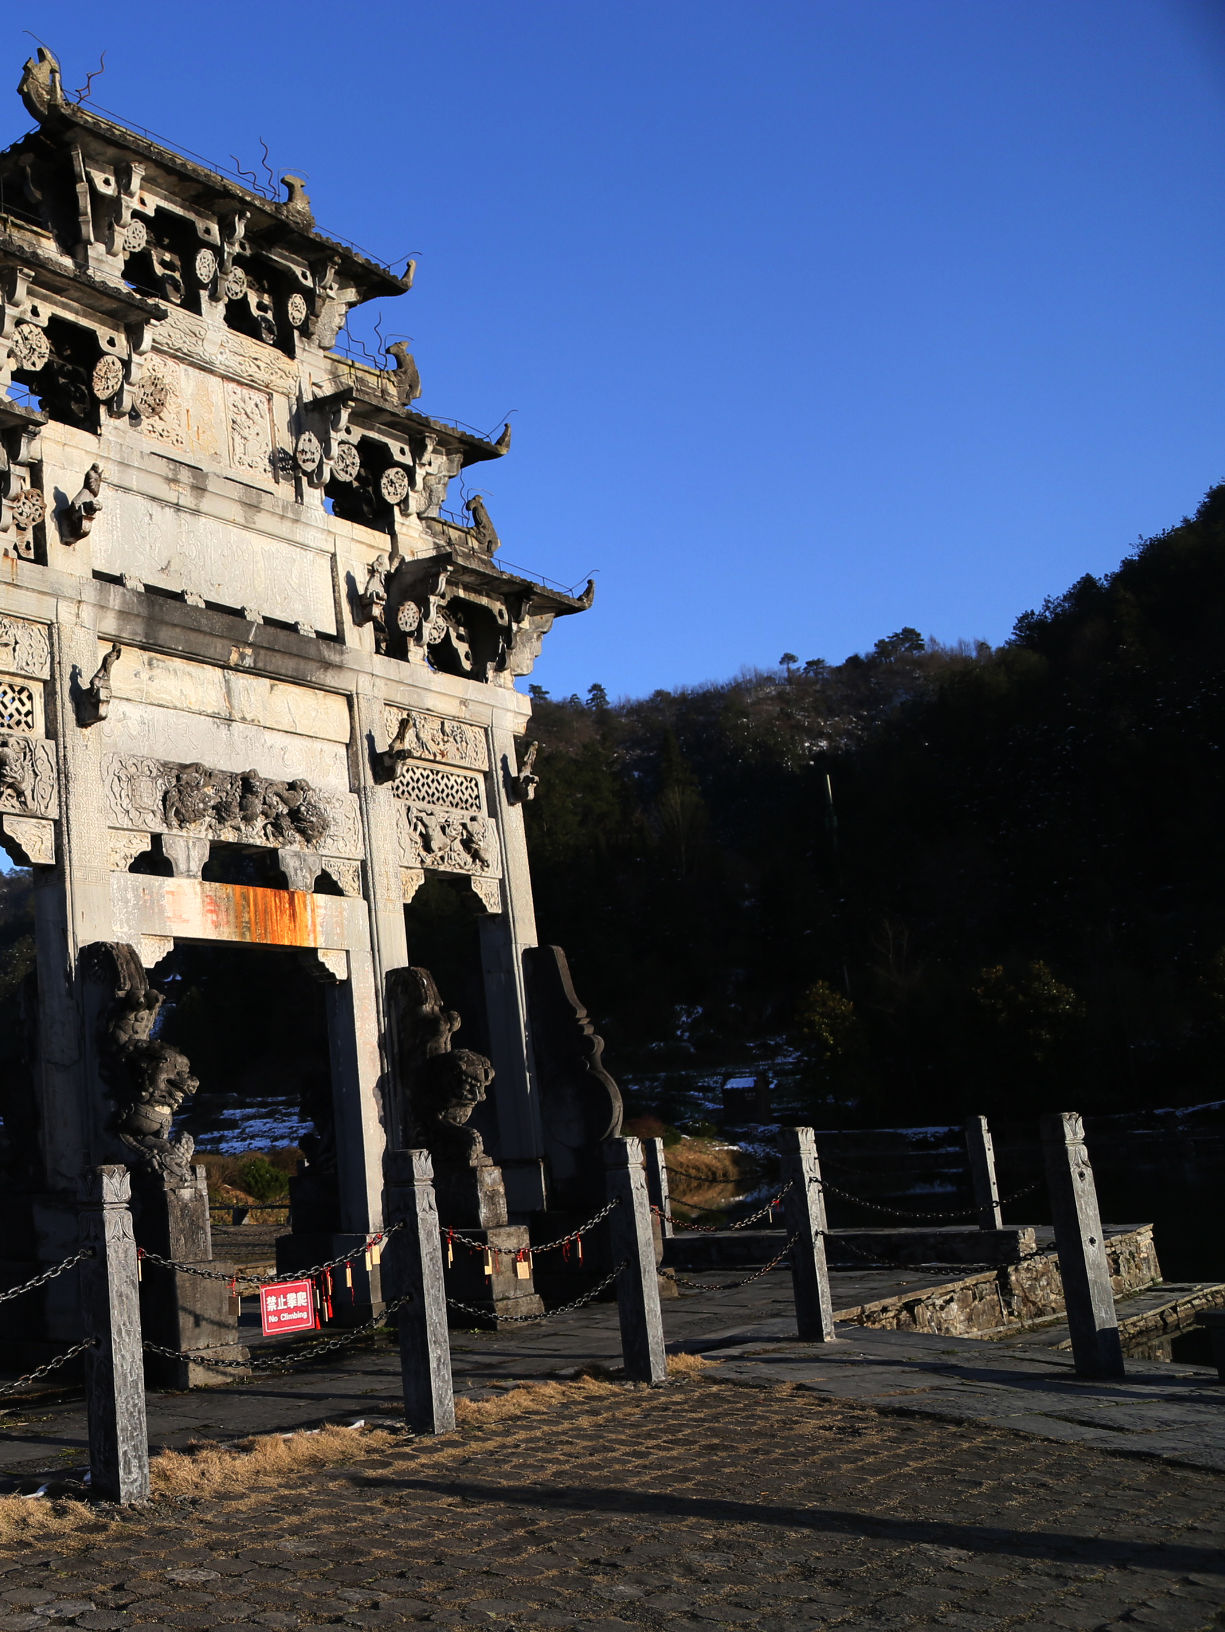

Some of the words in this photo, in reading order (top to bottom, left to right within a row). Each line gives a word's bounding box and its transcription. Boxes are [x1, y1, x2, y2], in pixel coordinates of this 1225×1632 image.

[266, 1292, 307, 1311] 禁止攀爬
[268, 1315, 278, 1323] No
[280, 1311, 307, 1320] Climbing
